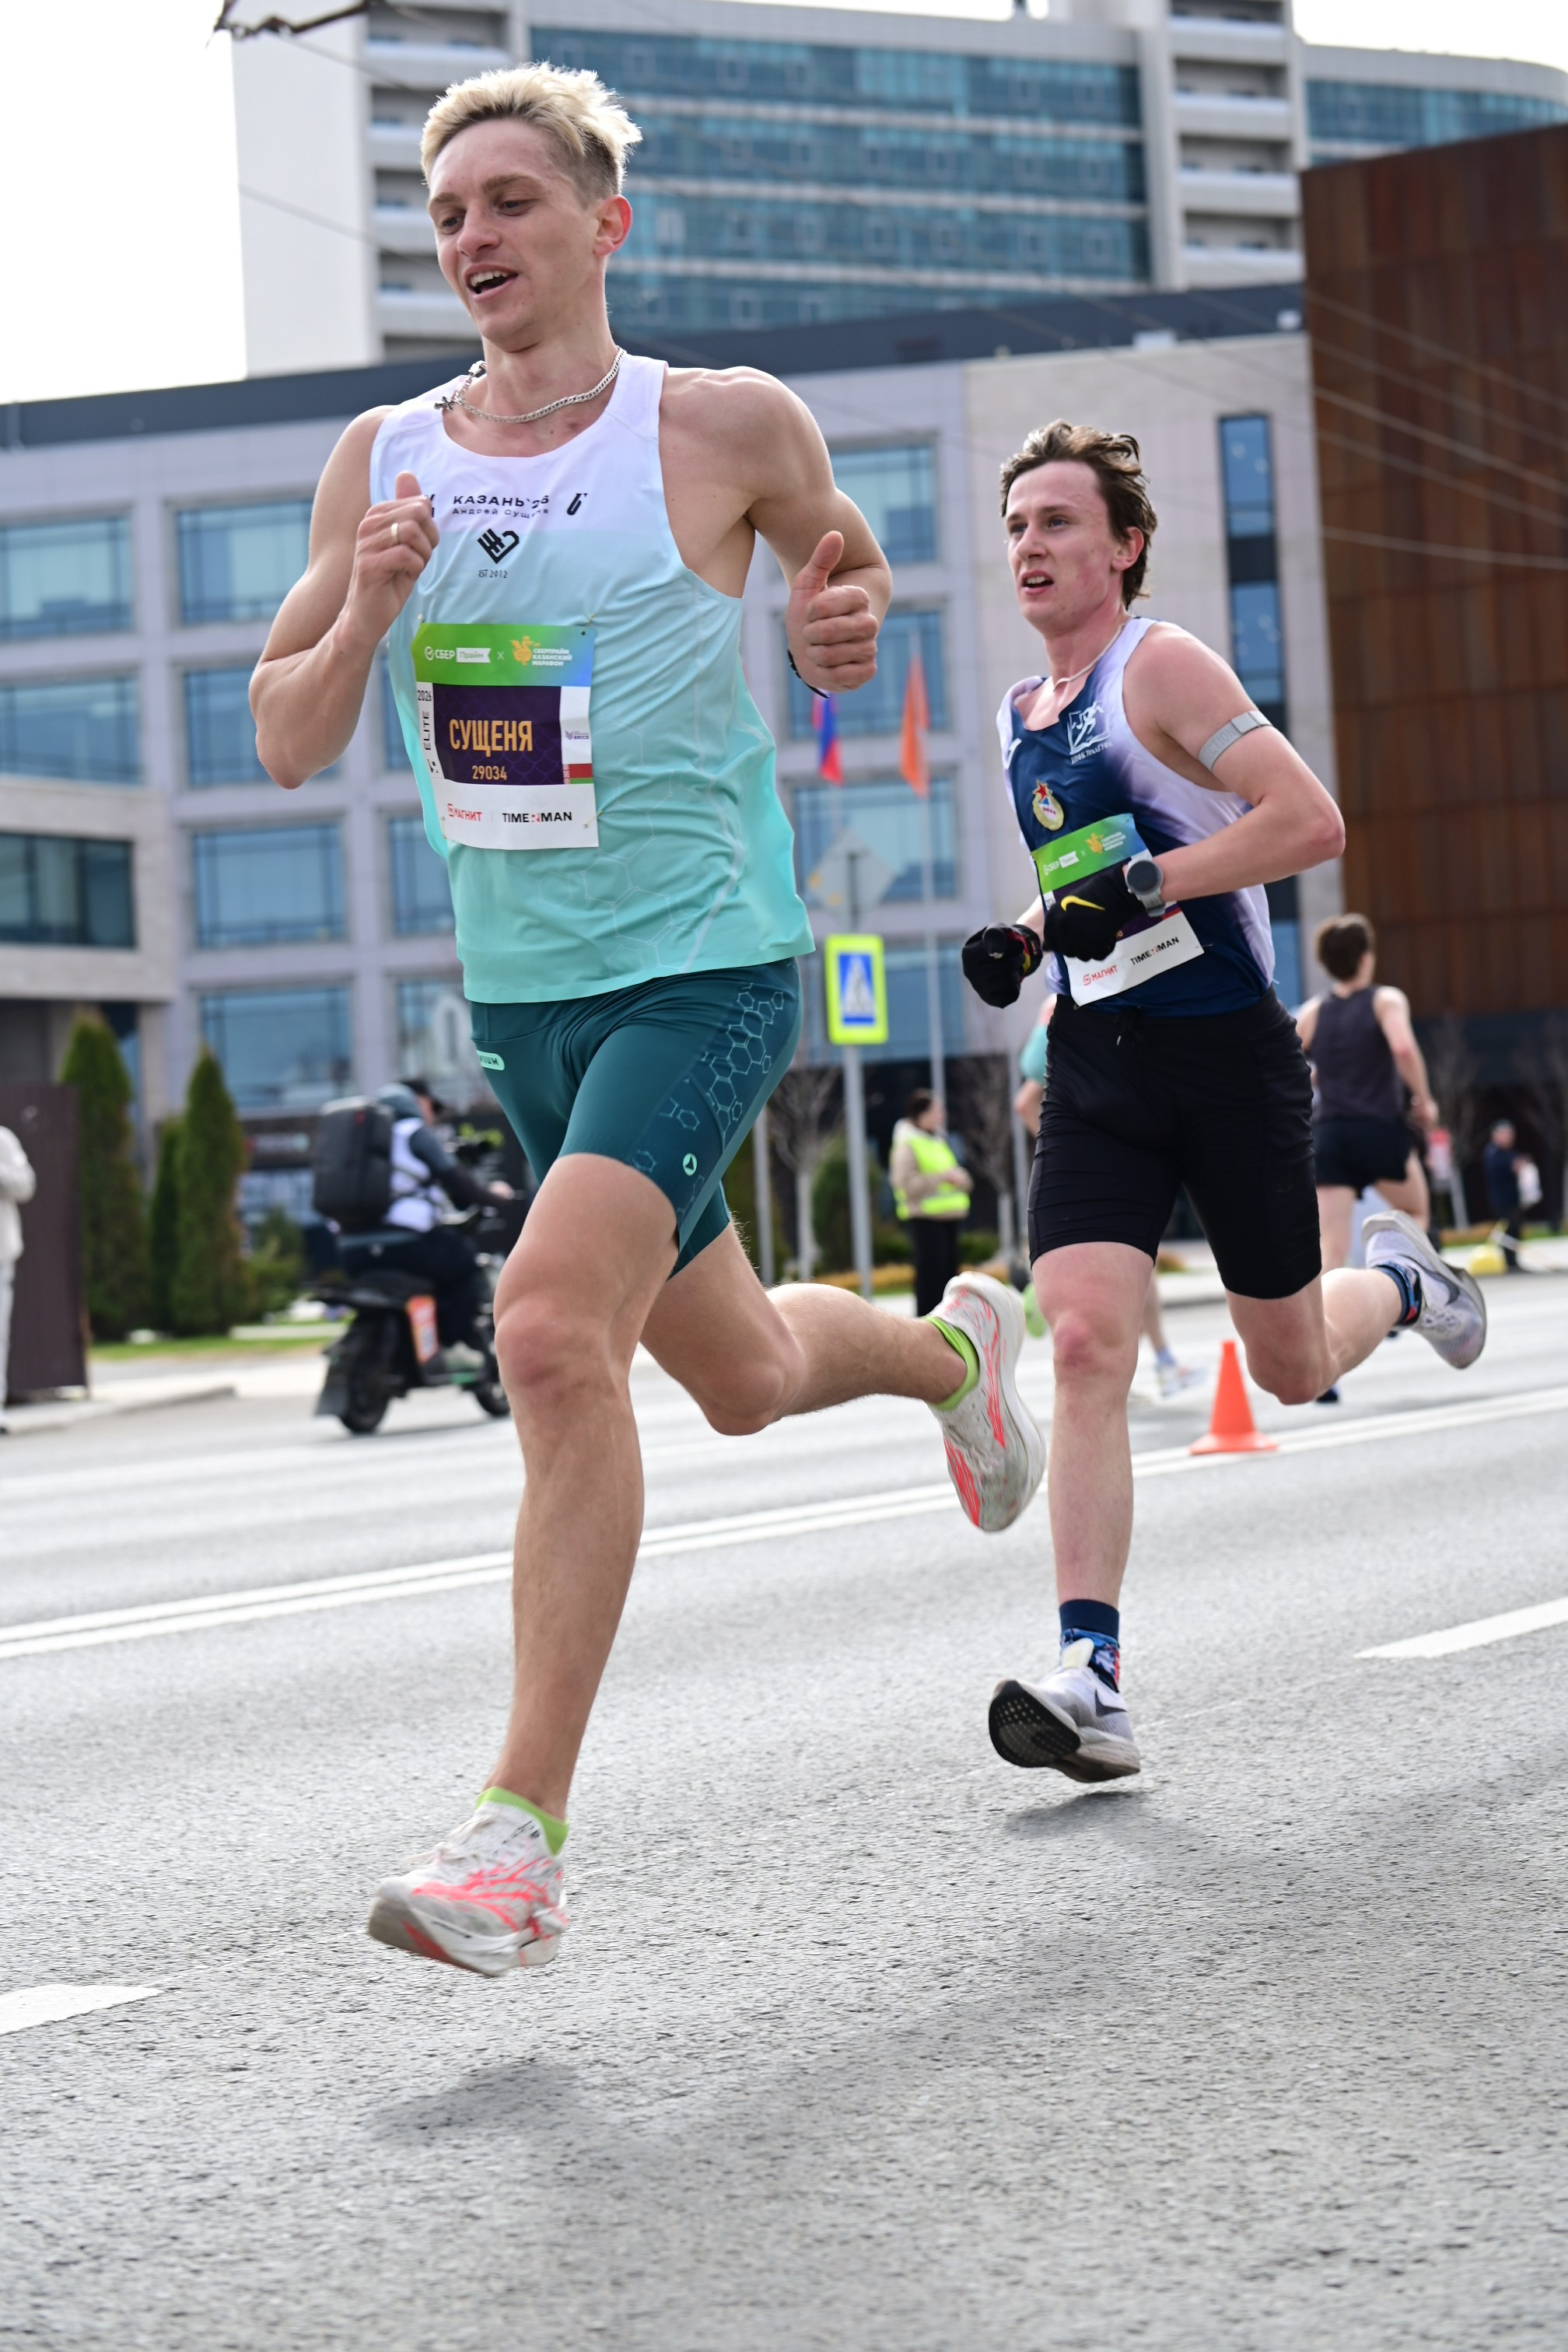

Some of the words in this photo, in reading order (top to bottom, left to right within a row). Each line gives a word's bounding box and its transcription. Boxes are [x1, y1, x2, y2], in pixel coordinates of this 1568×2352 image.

[422, 711, 431, 751] ELITE
[449, 719, 534, 758] СУЩЕНЯ
[471, 765, 508, 780] 29034
